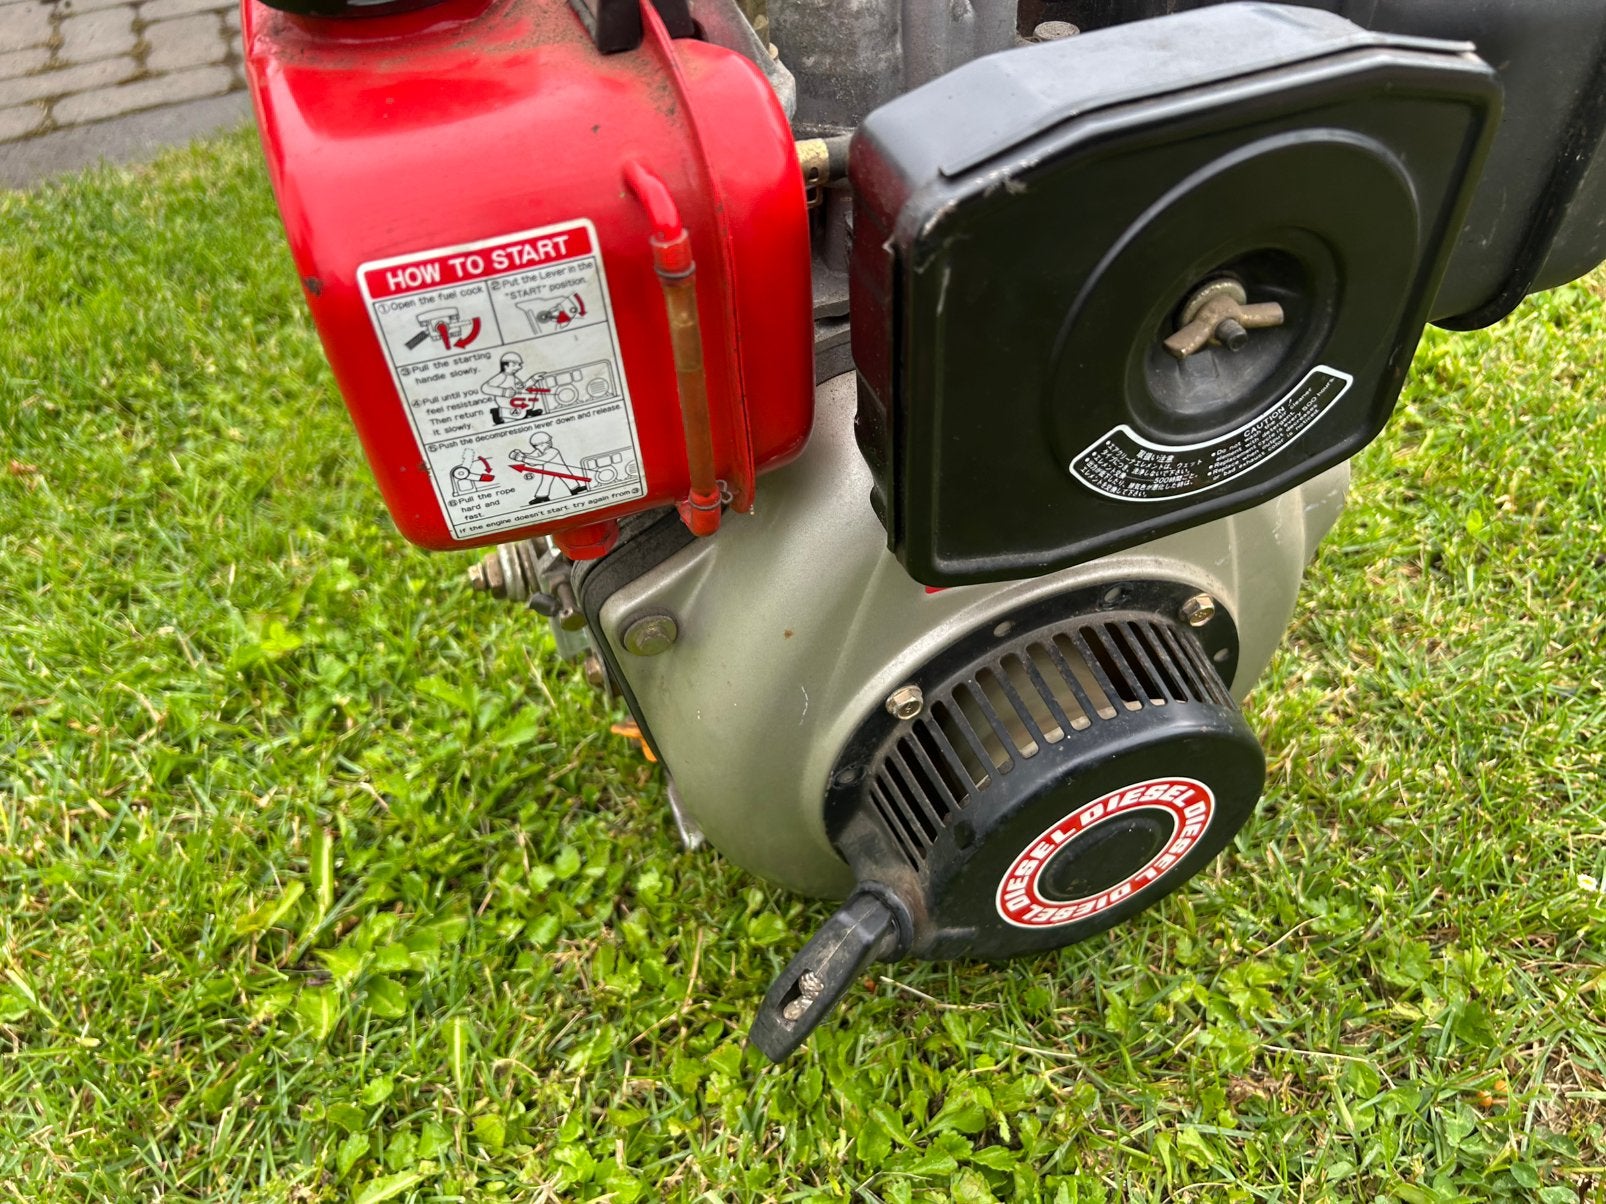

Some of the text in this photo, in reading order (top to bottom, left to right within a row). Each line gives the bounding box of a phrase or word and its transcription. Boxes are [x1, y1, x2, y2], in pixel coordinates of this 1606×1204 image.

[386, 235, 569, 291] HOW TO START
[521, 274, 538, 283] the
[539, 266, 567, 280] Lever
[568, 265, 576, 274] in
[577, 261, 593, 271] the
[418, 295, 435, 305] the
[438, 291, 457, 302] fuel
[460, 286, 483, 297] cock
[433, 359, 450, 369] the
[453, 352, 492, 366] starting
[415, 373, 446, 385] handle
[441, 391, 461, 402] until
[463, 388, 479, 398] you
[1301, 396, 1317, 412] 500
[426, 406, 444, 416] feel
[429, 409, 484, 425] Then return
[459, 436, 474, 445] the
[475, 424, 534, 442] decompression
[533, 420, 554, 430] lever
[555, 415, 576, 425] down
[577, 410, 591, 420] and
[1243, 406, 1285, 438] CAUTION
[477, 492, 492, 501] the
[495, 487, 516, 497] rope
[461, 499, 500, 513] hard and
[469, 523, 484, 532] the
[486, 518, 511, 528] engine
[514, 510, 545, 522] doesn't
[572, 501, 585, 509] try
[588, 495, 609, 505] again
[611, 489, 631, 499] from
[1080, 784, 1196, 827] DIESEL
[1135, 800, 1207, 882] DIESEL
[1003, 828, 1078, 913] DIESEL
[1021, 882, 1132, 923] DIESEL
